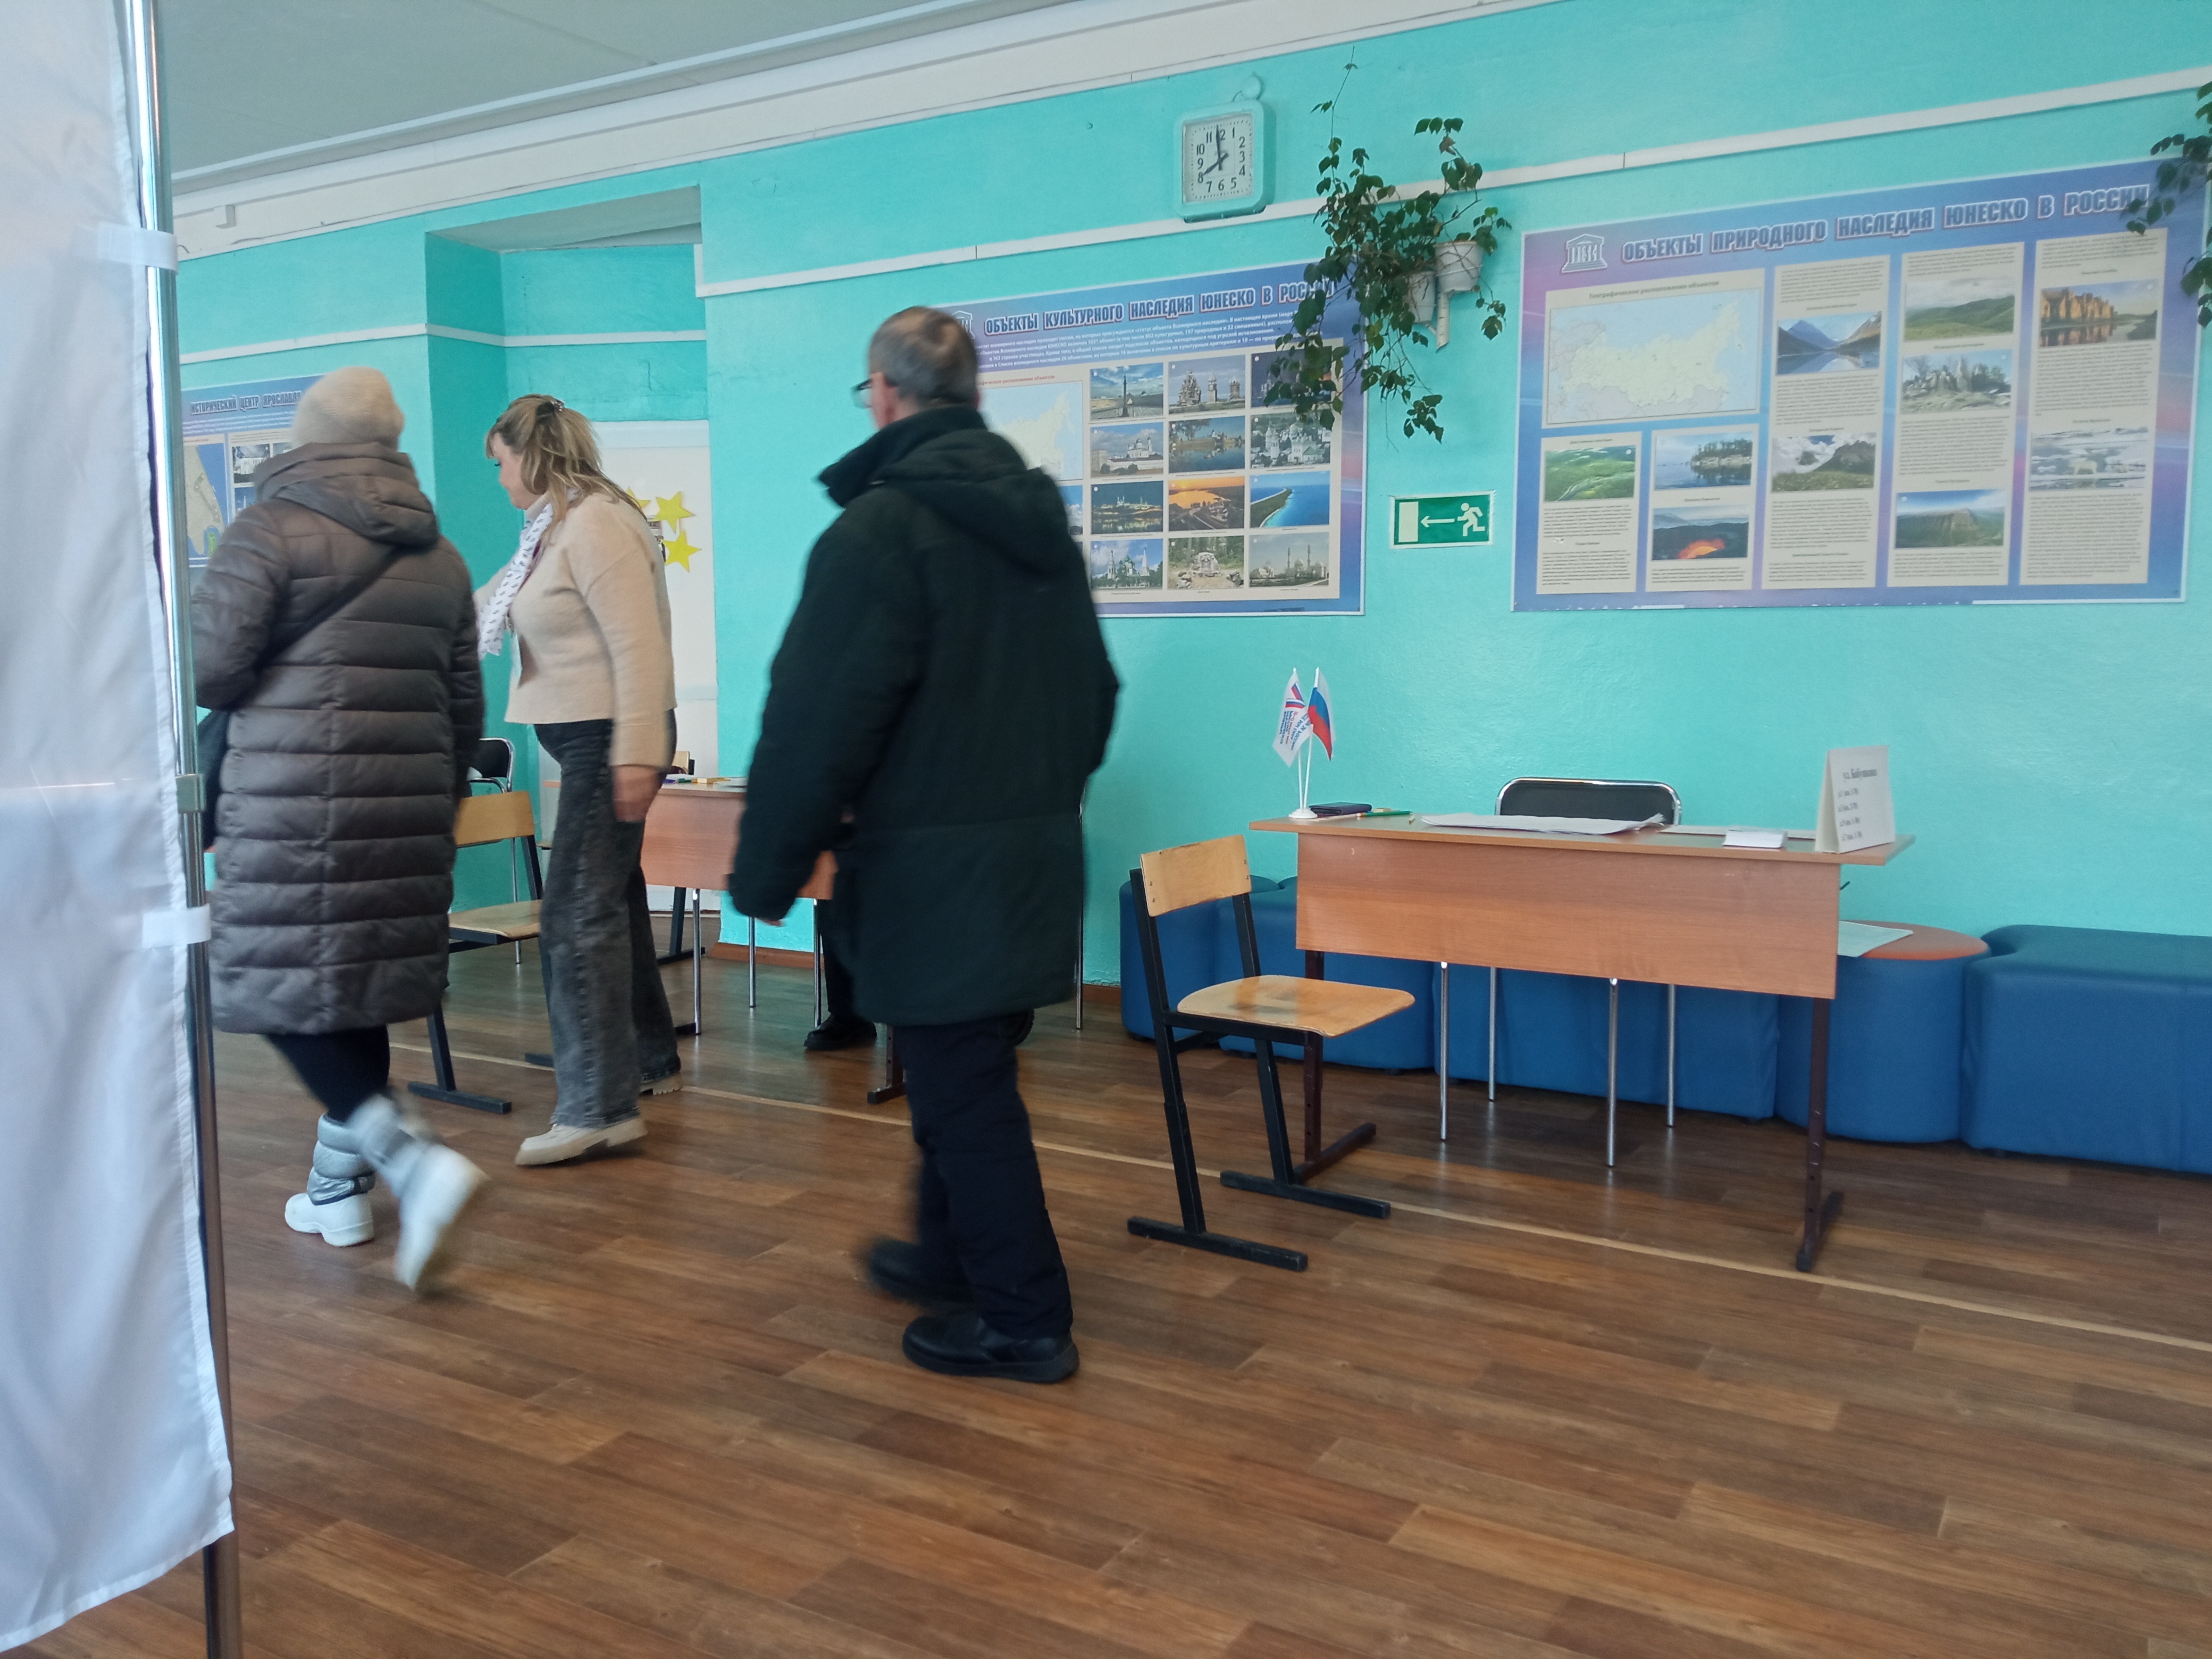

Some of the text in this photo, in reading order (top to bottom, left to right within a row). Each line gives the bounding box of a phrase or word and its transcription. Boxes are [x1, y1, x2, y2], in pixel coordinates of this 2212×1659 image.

[1206, 131, 1212, 143] 11
[1232, 127, 1235, 138] 1
[1239, 136, 1245, 148] 2
[1196, 144, 1205, 155] 10
[1239, 150, 1245, 163] 3
[1197, 158, 1203, 170] 9
[1239, 164, 1245, 176] 4
[1197, 172, 1204, 183] 8
[1230, 177, 1237, 189] 5
[1206, 181, 1212, 192] 7
[1218, 179, 1225, 191] 6
[1622, 184, 2150, 262] ОБЪЕКТЫ ПРИРОДНОГО НАСЛЕДИЯ ЮНЕСКО В РОССИИ
[985, 313, 1039, 336] ОБЪЕКТЫ
[1044, 304, 1124, 330] КУЛЬТУРНОГО
[1128, 295, 1195, 321] НАСЛЕДИЯ
[1200, 288, 1256, 313] ЮНЕСКО
[1261, 286, 1273, 305] В
[190, 395, 237, 415] ИСТОРИЧЕСКИЙ
[239, 395, 259, 412] ЦЕНТР
